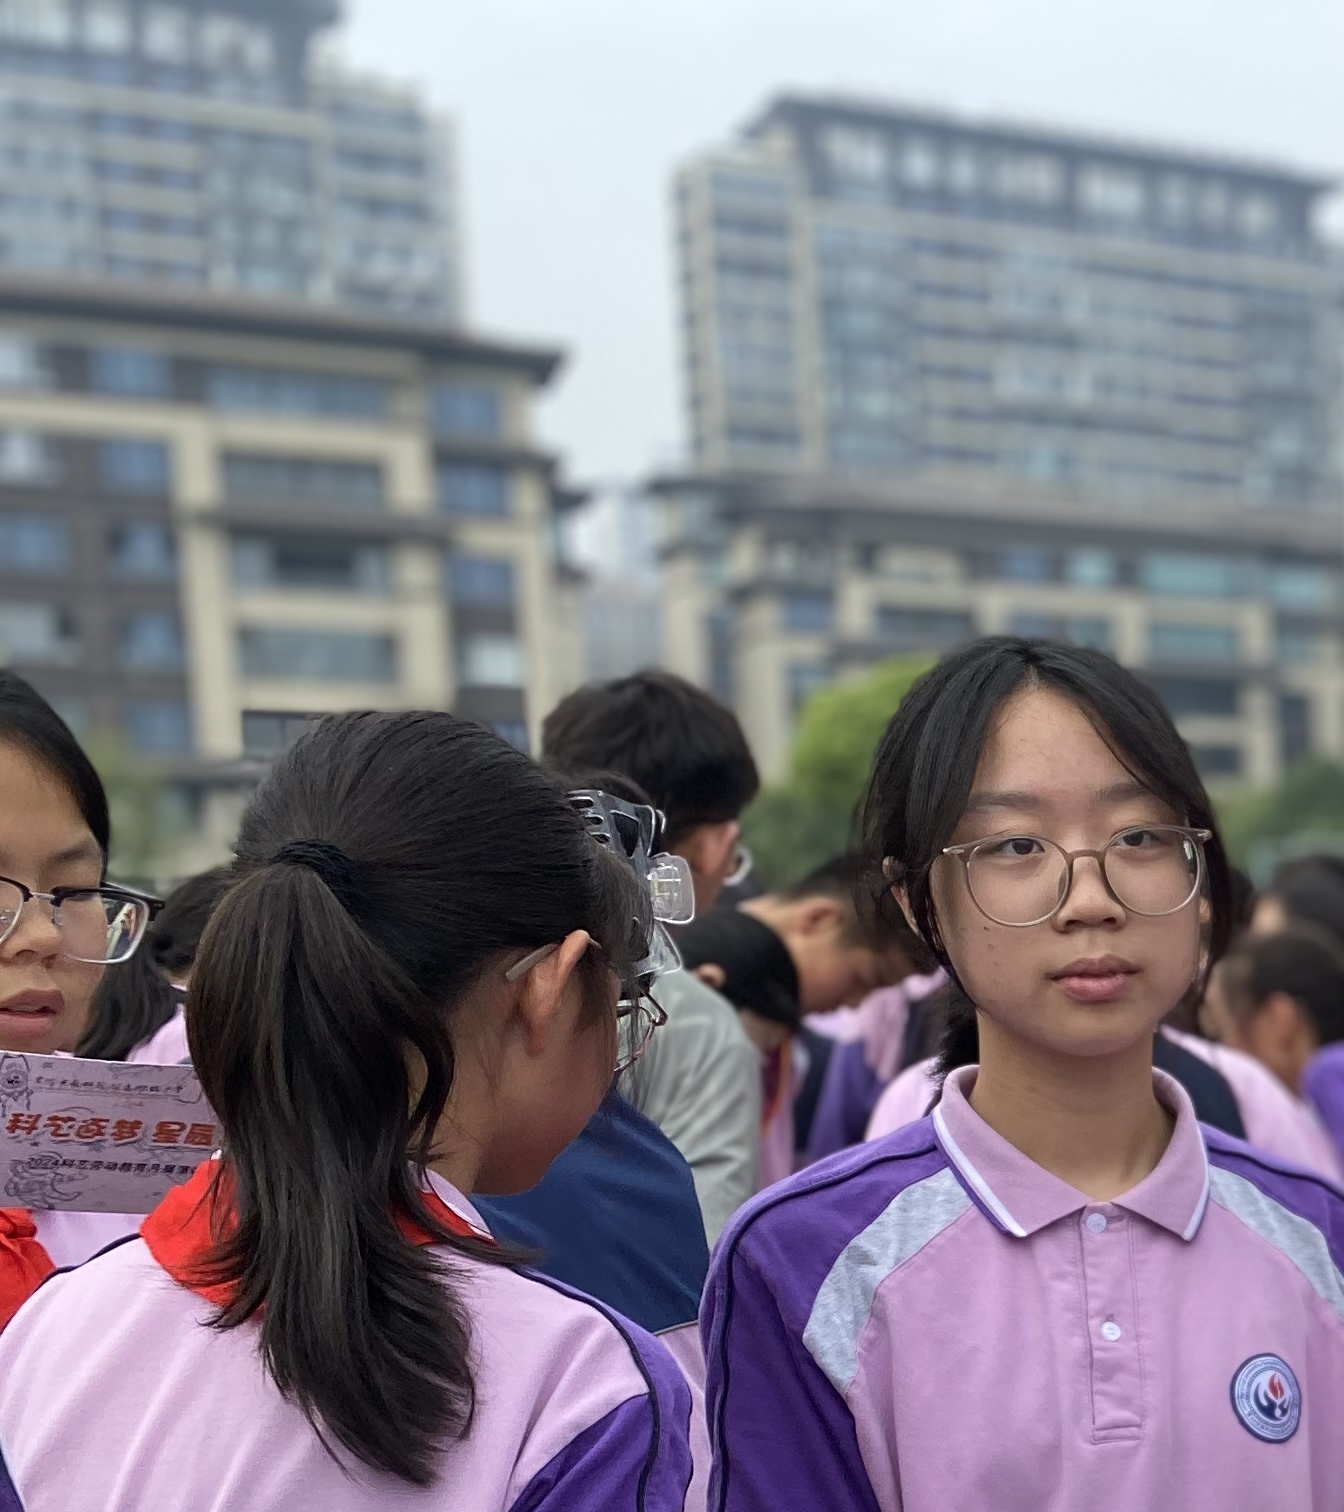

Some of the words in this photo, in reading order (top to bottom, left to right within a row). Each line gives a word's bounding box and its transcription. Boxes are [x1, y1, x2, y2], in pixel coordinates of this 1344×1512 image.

[6, 1112, 143, 1142] 科艺逐梦
[27, 1157, 197, 1175] 2024科艺劳动教育月展演
